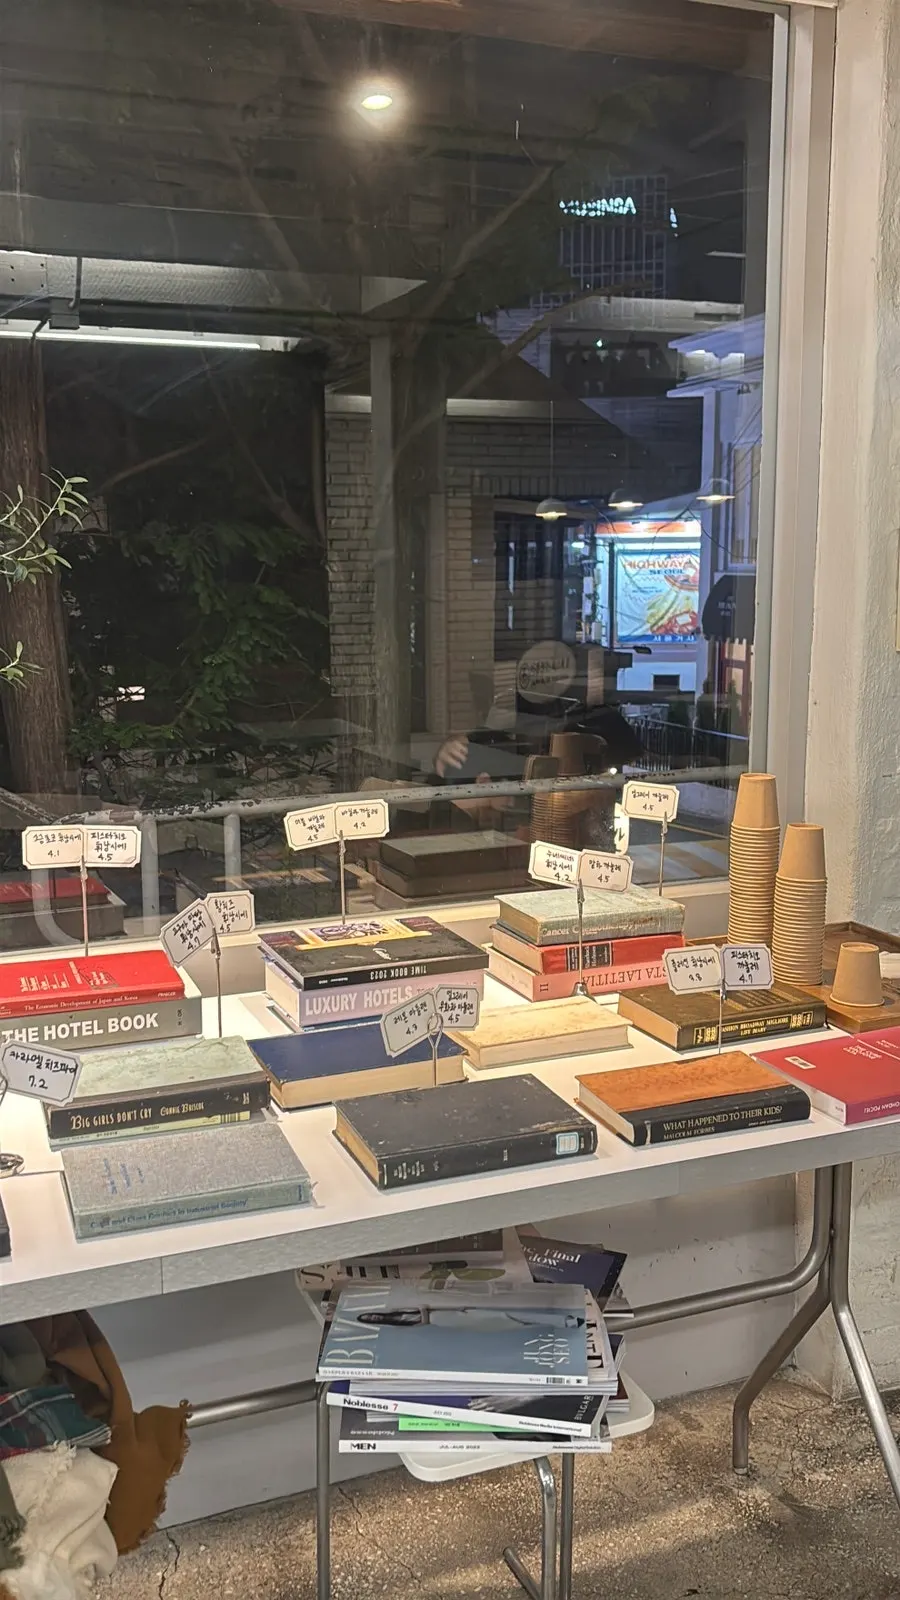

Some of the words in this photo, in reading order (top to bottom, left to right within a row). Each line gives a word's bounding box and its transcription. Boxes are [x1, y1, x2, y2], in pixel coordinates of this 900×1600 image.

[624, 560, 684, 569] HIGHWAY
[90, 832, 127, 840] 피스타치오
[94, 841, 127, 852] 휘낭시에
[97, 853, 113, 861] 4.5
[554, 872, 571, 882] 4.2
[597, 874, 610, 883] 4.5
[220, 924, 231, 933] 4.5
[370, 970, 387, 980] 2023
[390, 967, 407, 977] BOOK
[411, 965, 427, 975] TIME
[582, 969, 642, 987] LAETITIA
[306, 993, 358, 1016] LUXURY
[363, 985, 413, 1007] HOTELS
[448, 1013, 460, 1024] 4.5
[2, 1026, 40, 1044] THE
[43, 1018, 104, 1041] HOTEL
[108, 1012, 159, 1034] BOOK
[721, 1023, 739, 1033] ASHION
[740, 1020, 765, 1030] BROADWAY
[28, 1075, 48, 1089] 7.2
[70, 1114, 91, 1130] BIG
[93, 1112, 115, 1127] GIRLS
[117, 1109, 137, 1124] DON'T
[139, 1107, 152, 1120] CRY
[663, 1120, 687, 1132] WHAT
[688, 1112, 729, 1126] HAPPENED
[729, 1111, 741, 1121] TO
[741, 1108, 763, 1119] THEIR
[764, 1105, 783, 1116] KIDS?
[663, 1130, 693, 1140] MALCOLM
[694, 1126, 715, 1136] FORBES
[544, 1248, 581, 1263] Final
[343, 1398, 389, 1411] Noblesse
[392, 1402, 399, 1411] 7
